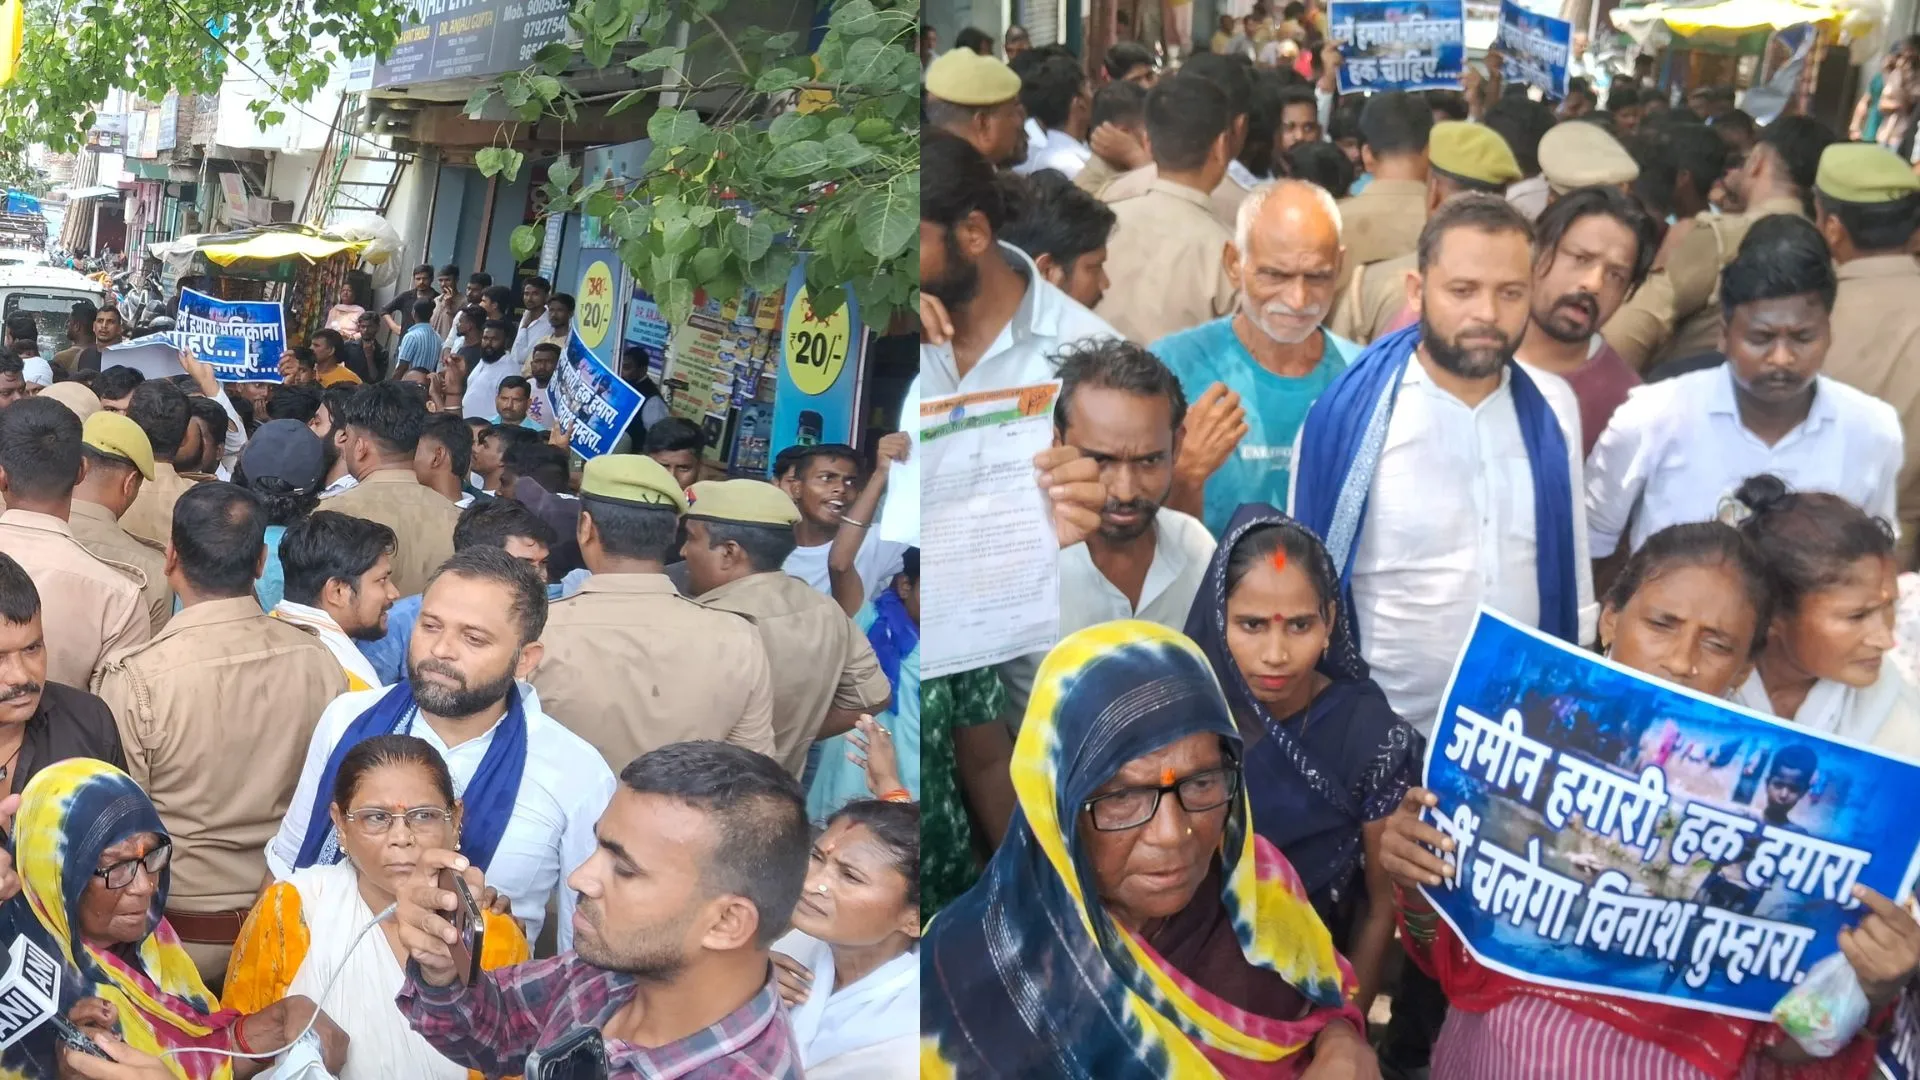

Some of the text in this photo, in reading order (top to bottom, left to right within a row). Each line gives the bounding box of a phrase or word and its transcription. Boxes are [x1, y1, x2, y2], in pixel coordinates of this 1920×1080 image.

[503, 3, 524, 21] Mob.
[1345, 57, 1378, 85] हक
[1445, 706, 1553, 801] जमीन
[1547, 753, 1669, 861] हमारी,
[1671, 801, 1757, 864] हक
[1472, 838, 1583, 940] चलेगा
[25, 946, 55, 997] ANI
